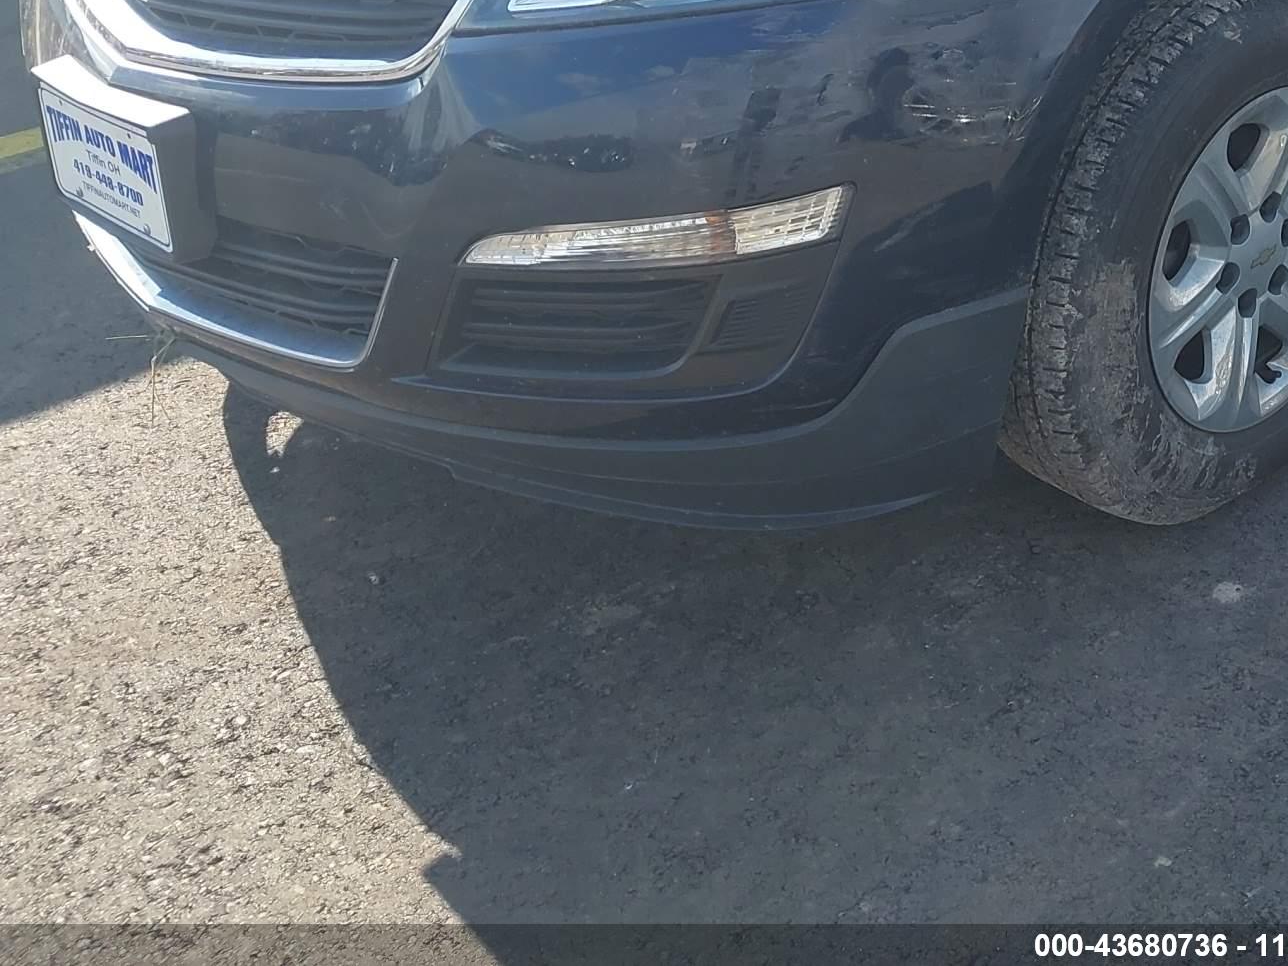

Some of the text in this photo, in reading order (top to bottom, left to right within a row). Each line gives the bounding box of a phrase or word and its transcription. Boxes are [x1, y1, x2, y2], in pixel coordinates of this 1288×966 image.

[46, 105, 158, 195] TIFFIN AUTO MART
[107, 160, 121, 176] OH
